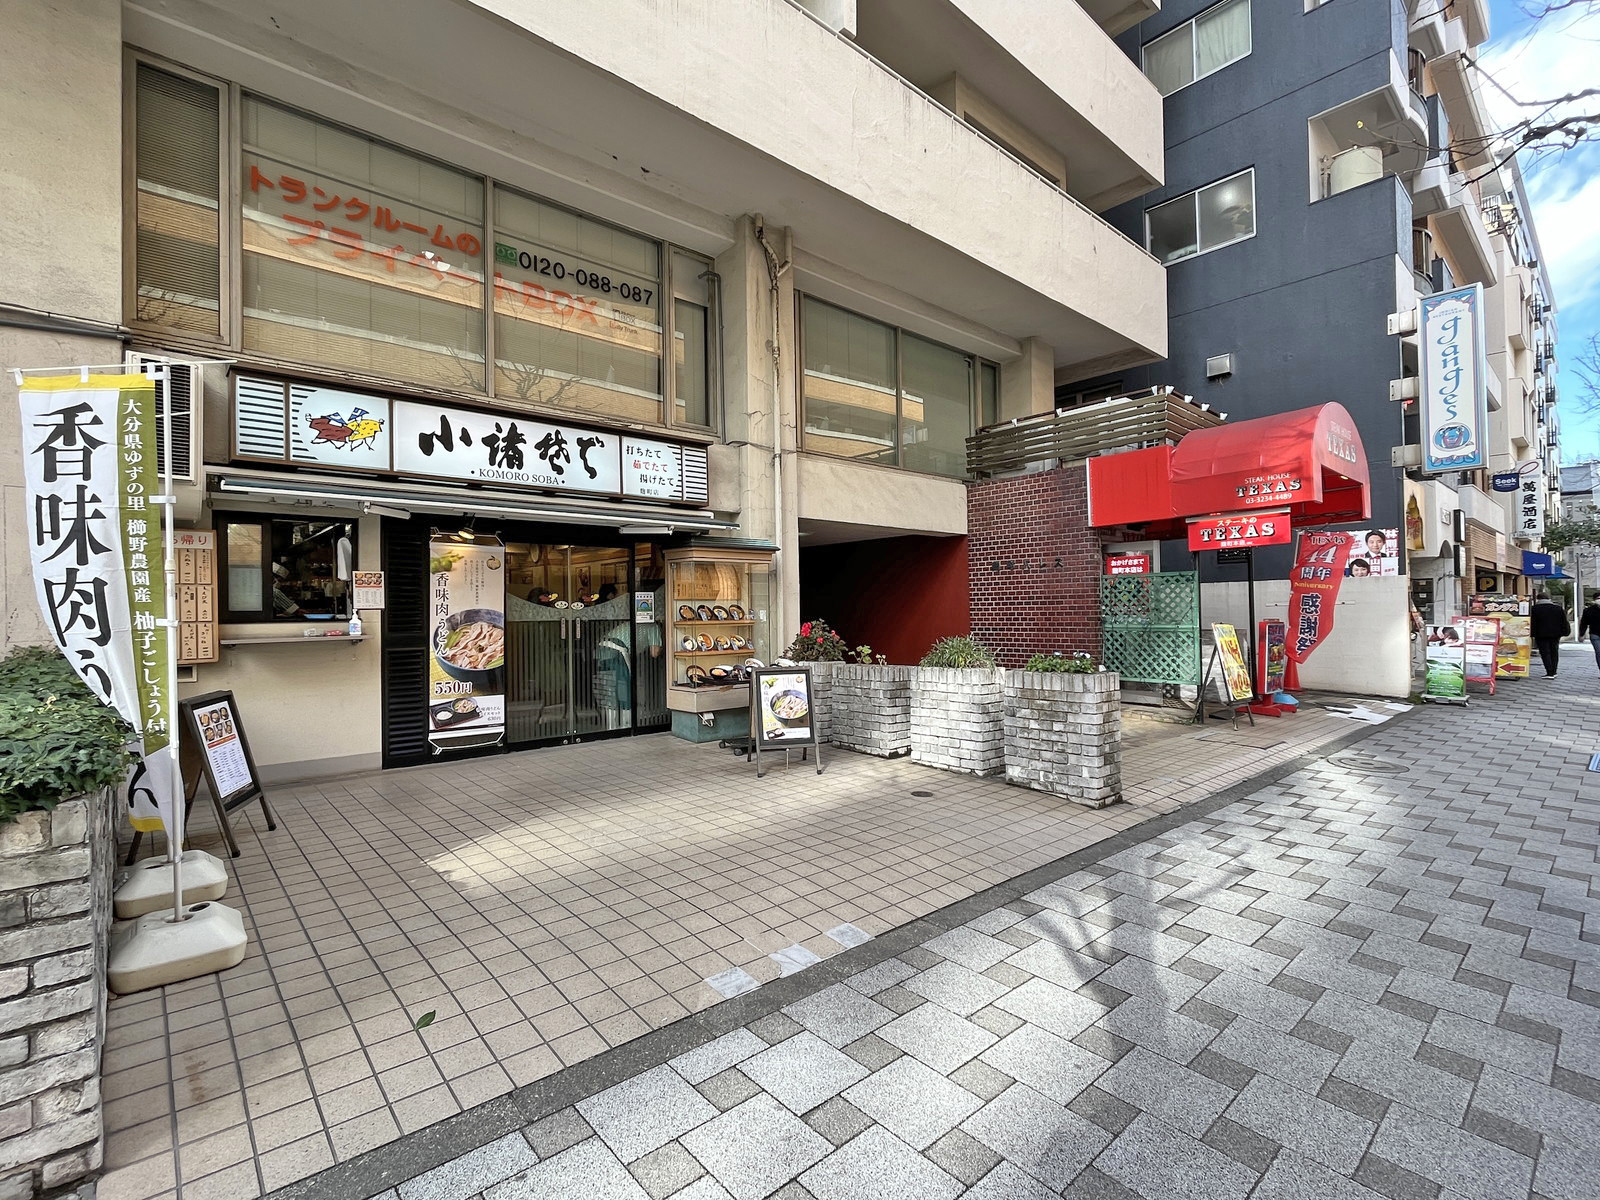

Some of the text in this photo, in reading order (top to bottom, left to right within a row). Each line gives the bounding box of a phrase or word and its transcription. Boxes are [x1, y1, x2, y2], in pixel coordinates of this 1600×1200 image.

[249, 165, 481, 256] トランクルームの
[519, 251, 653, 305] 0120-088-087
[1437, 315, 1464, 421] ganges
[123, 398, 147, 511] 大分県ゆずの里
[626, 445, 662, 459] 打ちたて
[1327, 432, 1357, 463] TEXAS
[633, 460, 668, 473] 茹でたて
[478, 468, 560, 485] KOMORO SOBA
[640, 474, 674, 487] 揚げたて
[1244, 472, 1291, 484] STEAK HOUSE
[1495, 477, 1517, 485] Seek
[1235, 478, 1301, 498] TEXAS
[1217, 517, 1258, 527] ステーキの
[1200, 522, 1276, 542] TEXAS
[1311, 535, 1346, 546] TEXAS
[126, 519, 152, 603] 櫛野農園産
[1301, 566, 1331, 581] 周年
[1479, 578, 1495, 591] P
[435, 572, 450, 656] 香味肉うどん
[435, 681, 473, 695] 550円
